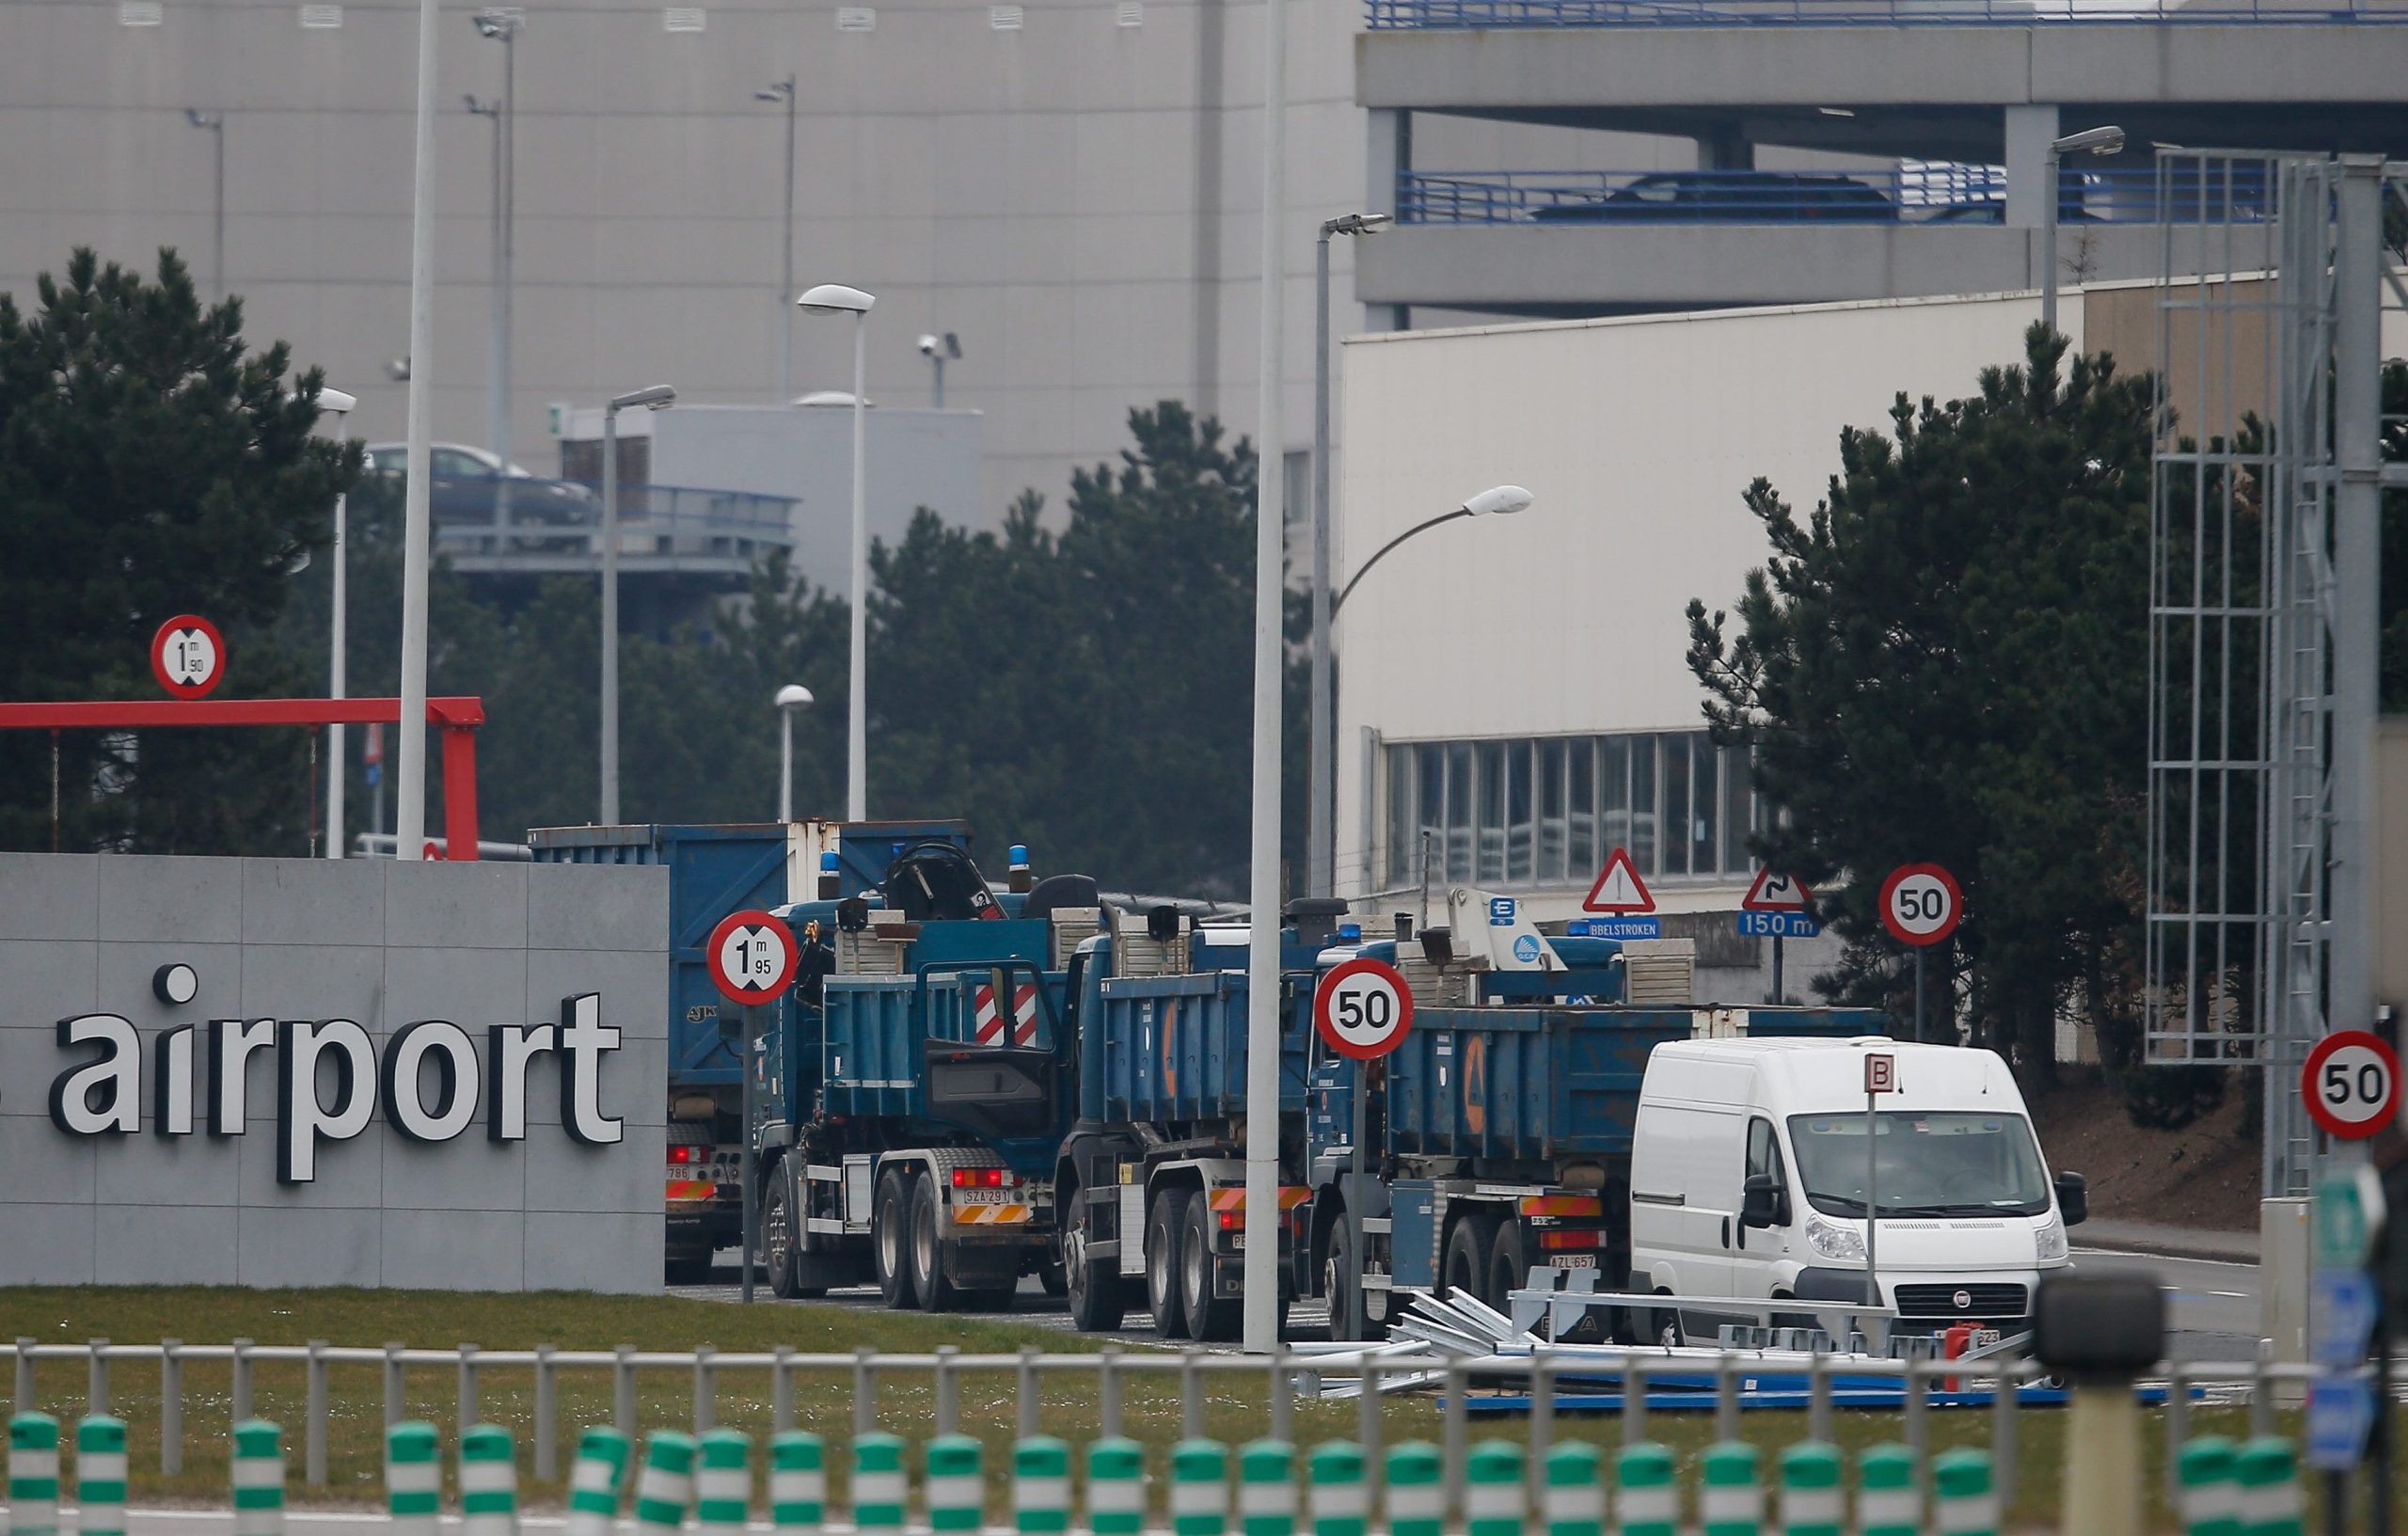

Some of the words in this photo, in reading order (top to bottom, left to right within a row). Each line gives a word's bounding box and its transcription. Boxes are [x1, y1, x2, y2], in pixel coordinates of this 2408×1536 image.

[179, 641, 186, 672] 1
[190, 658, 204, 672] 90
[1900, 889, 1942, 920] 50
[1590, 924, 1656, 936] IBBELSTROKEN
[1746, 914, 1785, 933] 150
[1794, 919, 1813, 934] m
[736, 940, 749, 974] 1
[756, 941, 768, 952] m
[755, 959, 771, 974] 95
[1339, 990, 1390, 1029] 50
[49, 962, 624, 1183] airport
[1874, 1061, 1889, 1085] B
[2325, 1063, 2383, 1104] 50
